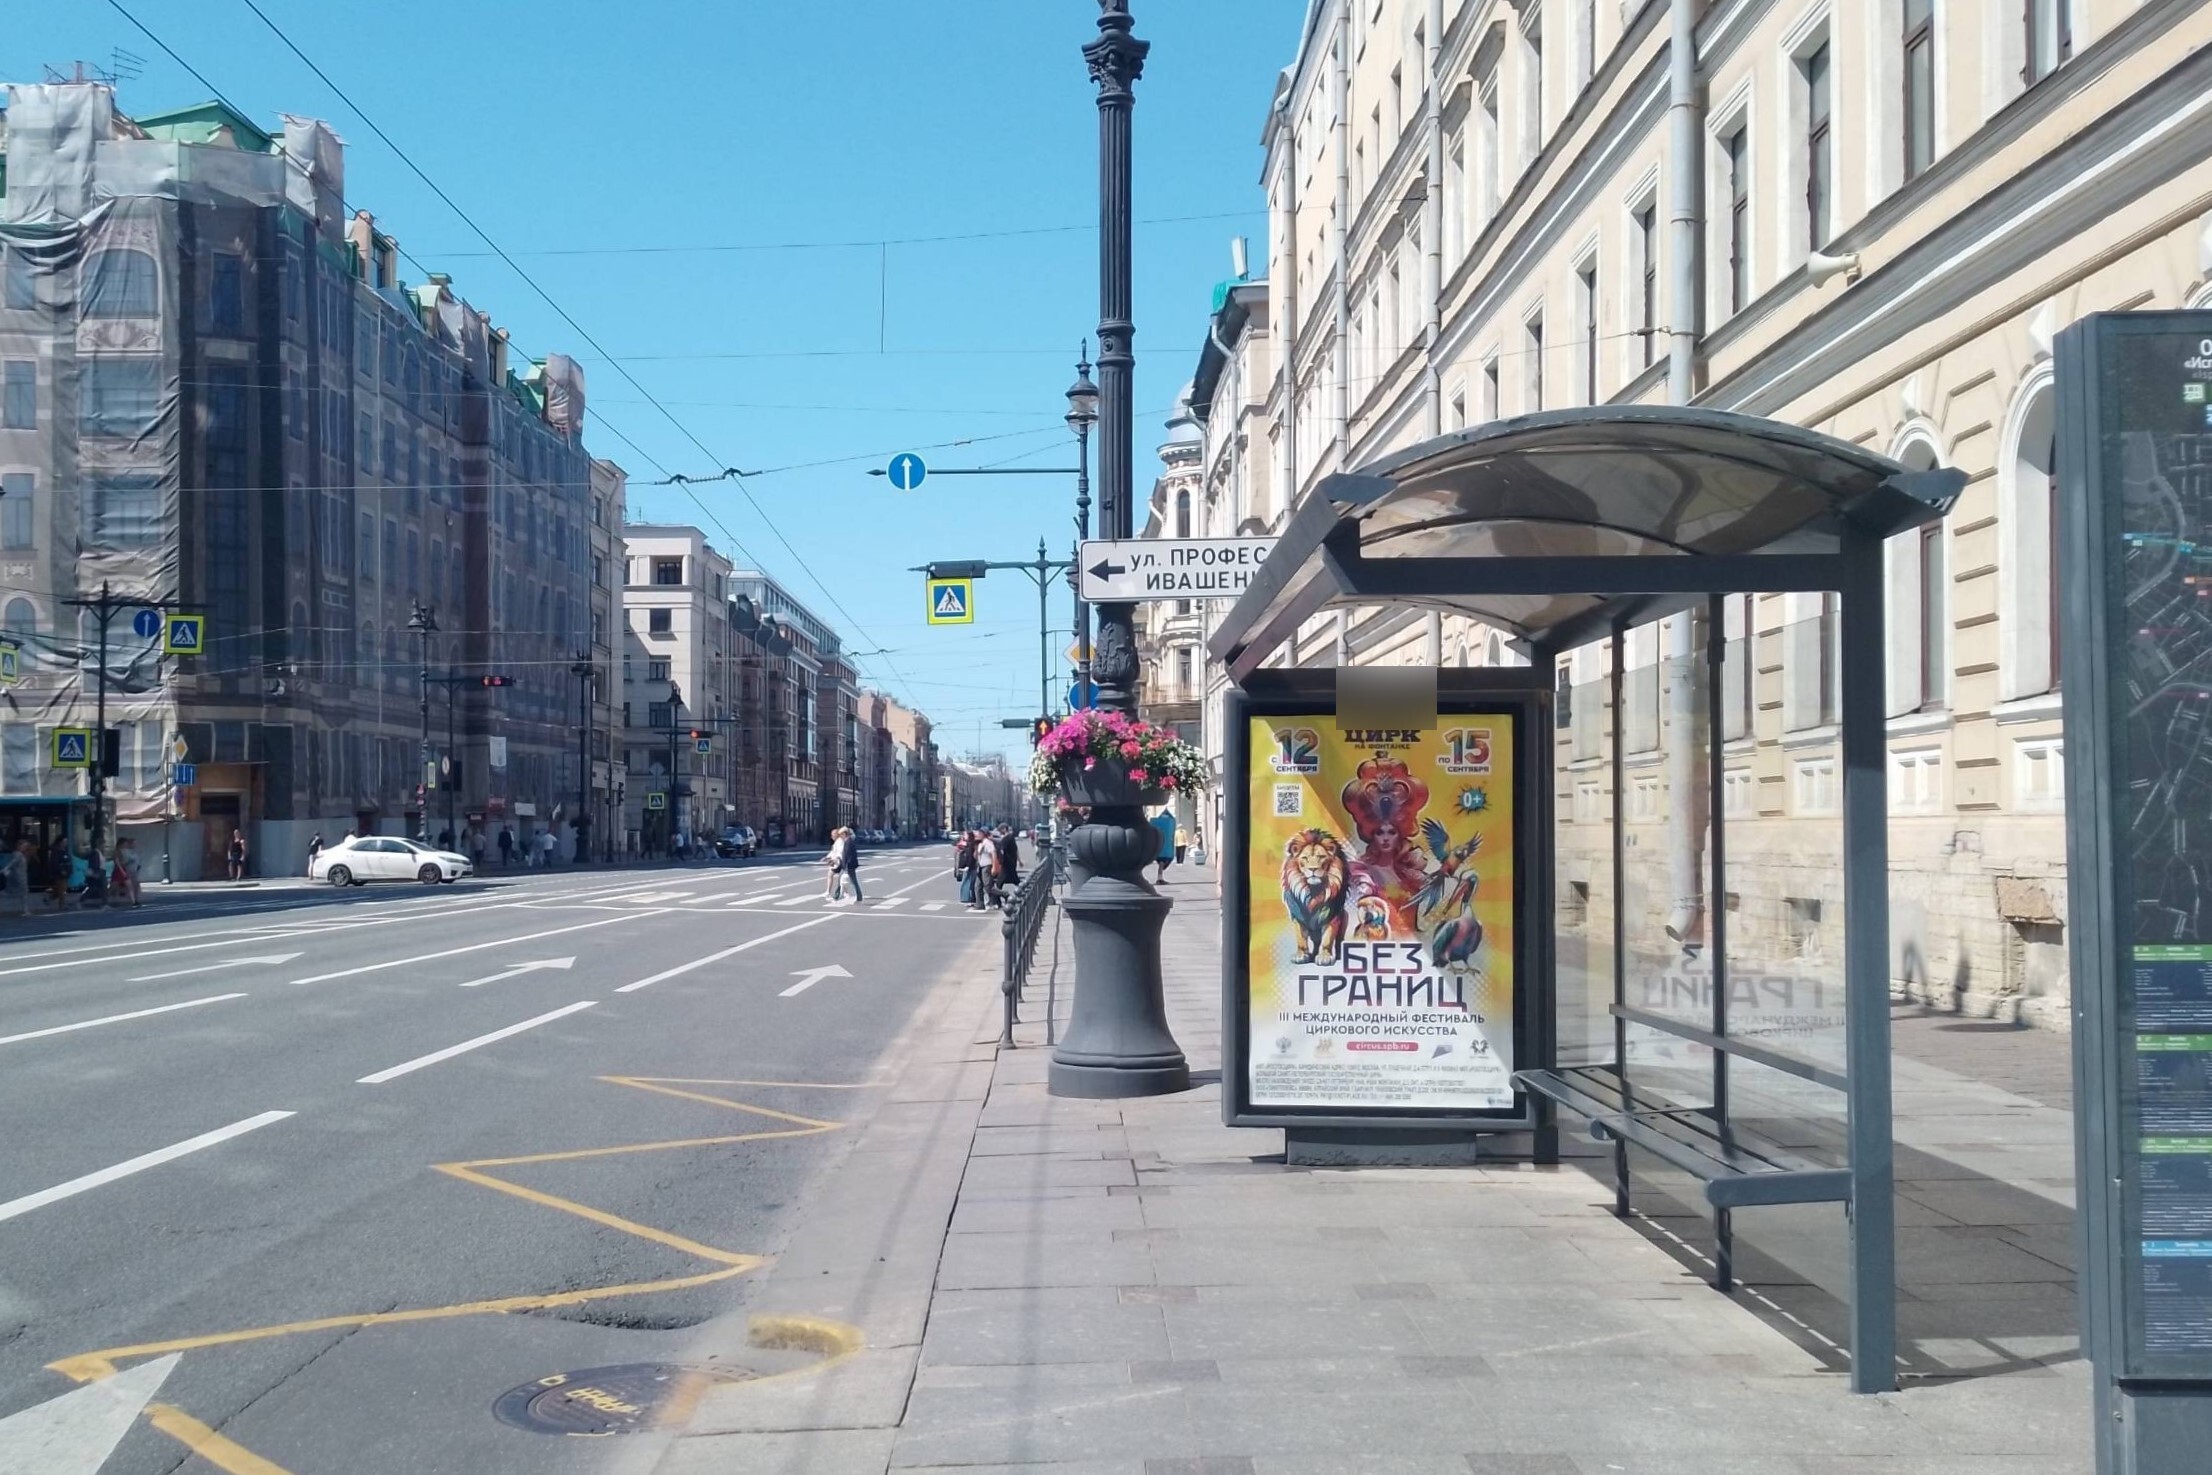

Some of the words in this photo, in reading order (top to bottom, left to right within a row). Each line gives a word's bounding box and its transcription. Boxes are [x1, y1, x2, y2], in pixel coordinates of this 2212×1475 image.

[1131, 554, 1161, 572] ул.
[1170, 546, 1267, 566] ПРОФЕС
[1146, 571, 1255, 590] ИВАШЕН
[1274, 729, 1318, 764] 12
[1344, 729, 1421, 743] ЦИРК
[1444, 729, 1490, 764] 15
[1463, 792, 1482, 807] 0+
[1342, 942, 1423, 974] БЕЗ
[1298, 975, 1468, 1012] ГРАНИЦ
[1279, 1012, 1289, 1021] III
[1293, 1011, 1408, 1023] МЕЖДУНАРОДНЫЙ
[1411, 1013, 1485, 1024] ФЕСТИВАЛЬ
[1306, 1025, 1380, 1035] ЦИРКОВОГО
[1384, 1026, 1458, 1036] ИСКУССТВА
